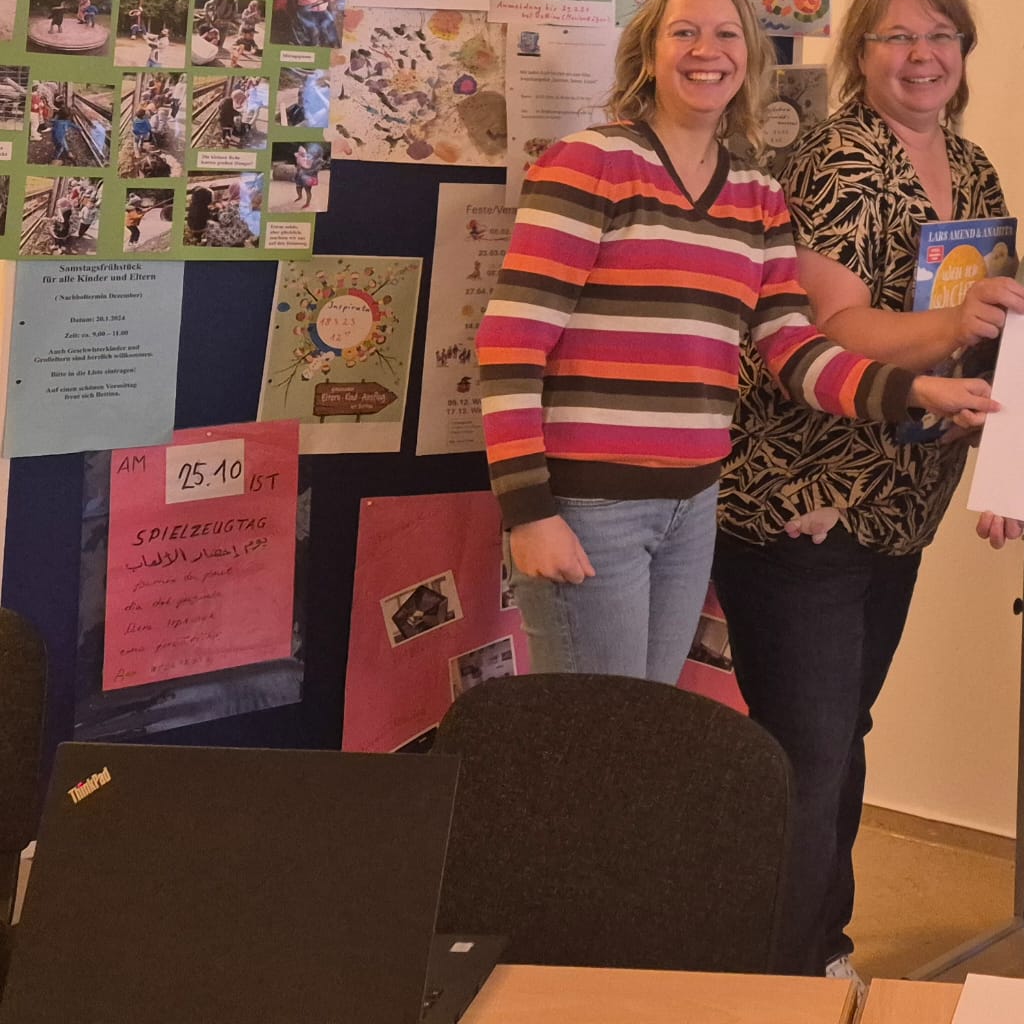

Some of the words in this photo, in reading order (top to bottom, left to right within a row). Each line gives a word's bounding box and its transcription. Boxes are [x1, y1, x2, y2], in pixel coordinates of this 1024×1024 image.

[928, 230, 948, 242] LARS
[950, 228, 976, 241] AMEND
[59, 263, 142, 273] Samstagsfrühstück
[59, 275, 75, 283] alle
[78, 274, 108, 283] Kinder
[130, 273, 156, 281] Eltern
[67, 346, 126, 354] Geschwisterkinder
[117, 455, 146, 474] AM
[178, 458, 242, 490] 25.10
[250, 473, 280, 492] IST
[132, 517, 268, 546] SPIELZEUGTAG
[68, 766, 111, 804] ThinkPad
